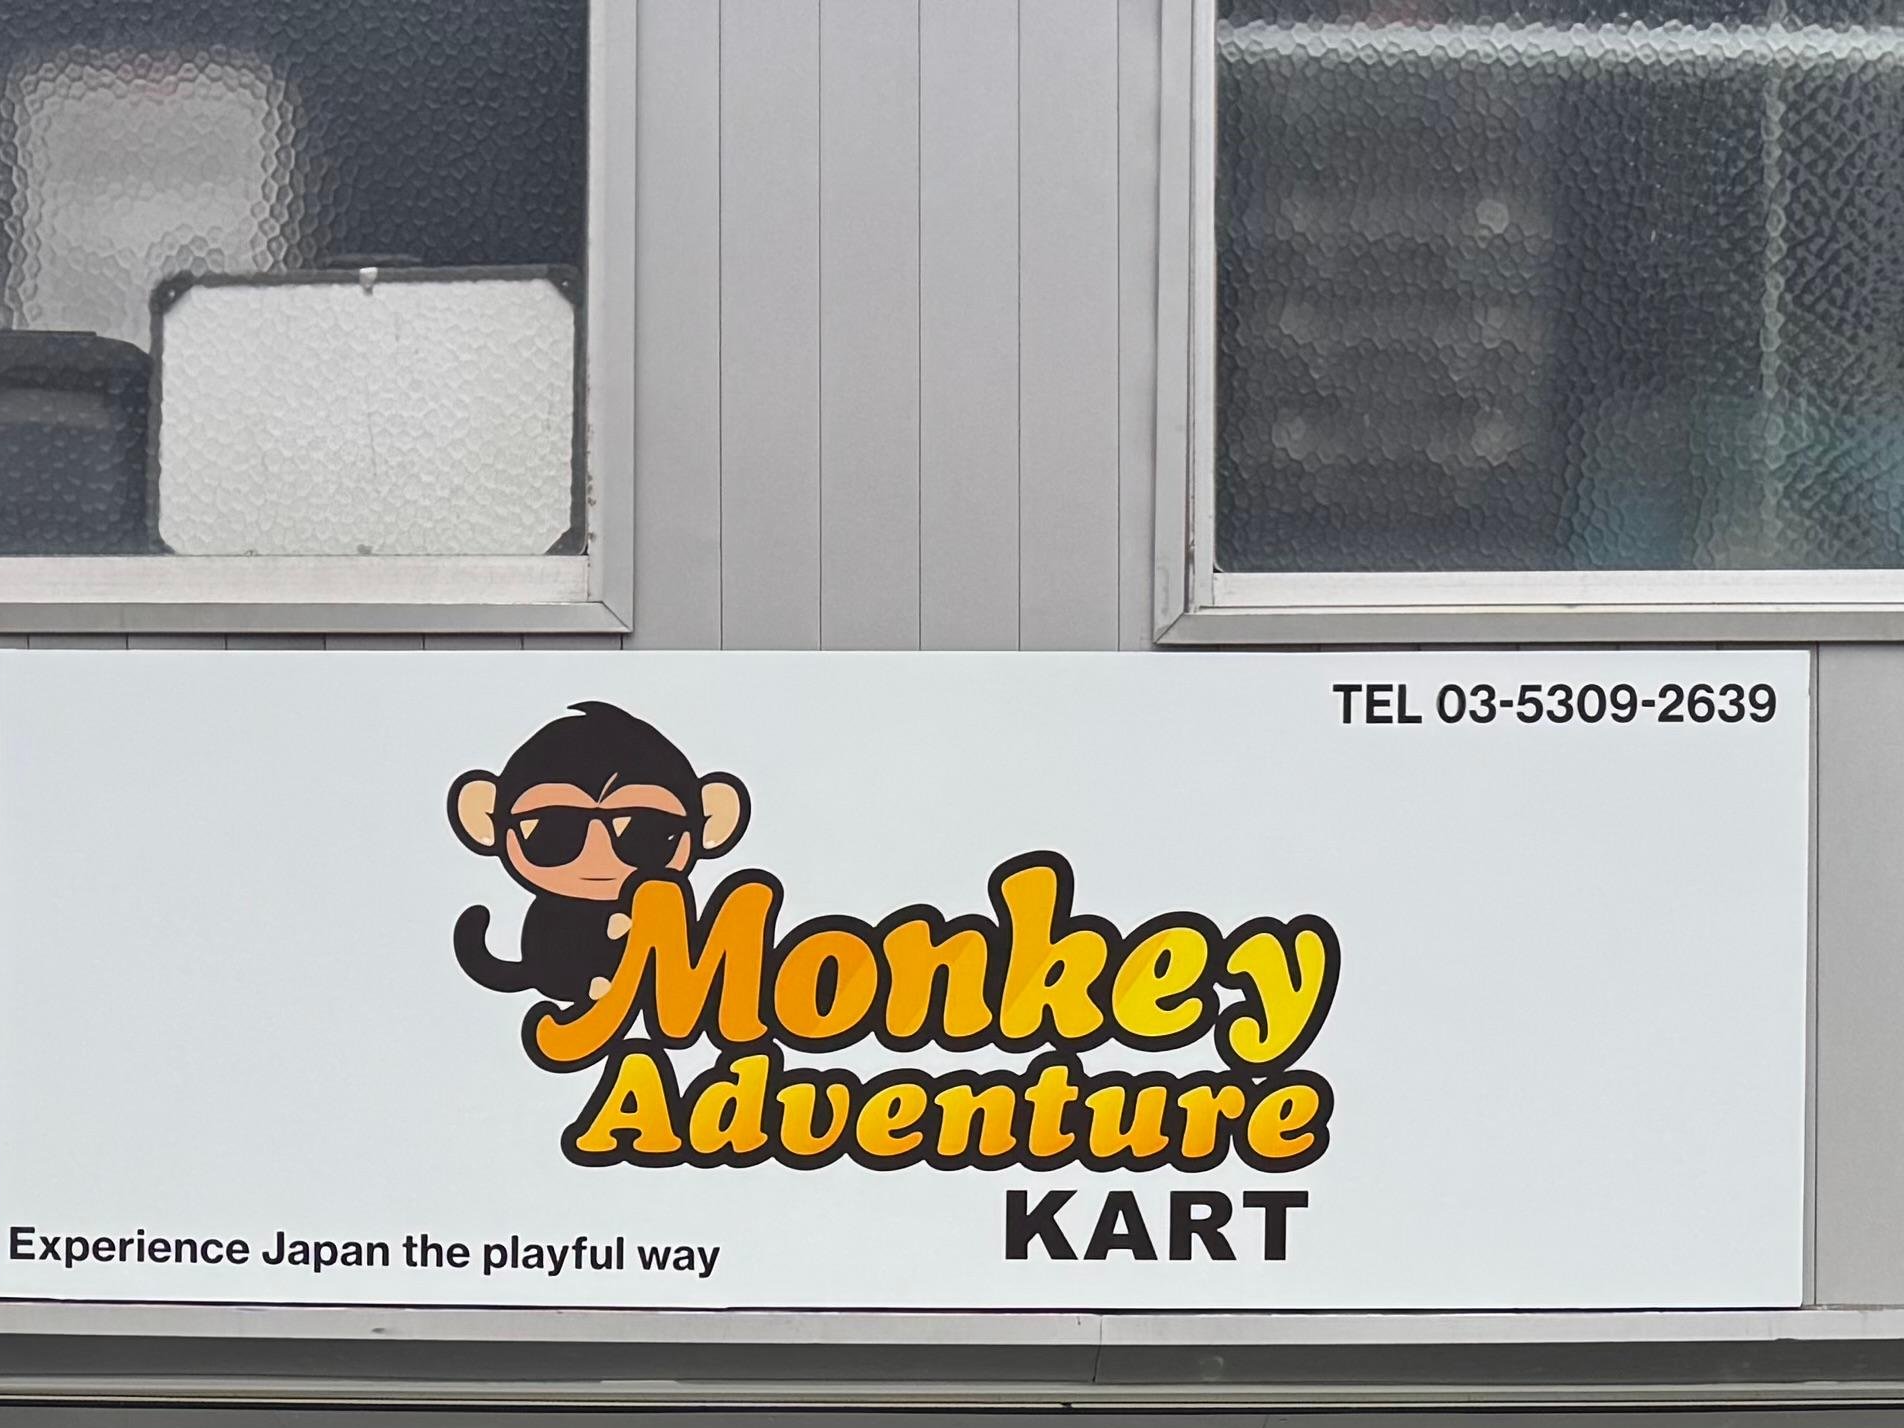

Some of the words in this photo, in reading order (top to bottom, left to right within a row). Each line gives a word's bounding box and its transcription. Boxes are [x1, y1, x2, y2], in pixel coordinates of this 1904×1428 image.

[1332, 684, 1423, 724] TEL
[1437, 683, 1777, 724] 03-5309-2639
[524, 852, 1339, 1074] Monkey
[568, 1045, 1328, 1167] Adventure
[9, 1226, 250, 1269] Experience
[262, 1231, 390, 1273] Japan
[402, 1233, 470, 1268] the
[483, 1235, 624, 1277] playful
[637, 1246, 721, 1279] way
[1005, 1189, 1309, 1261] KART
